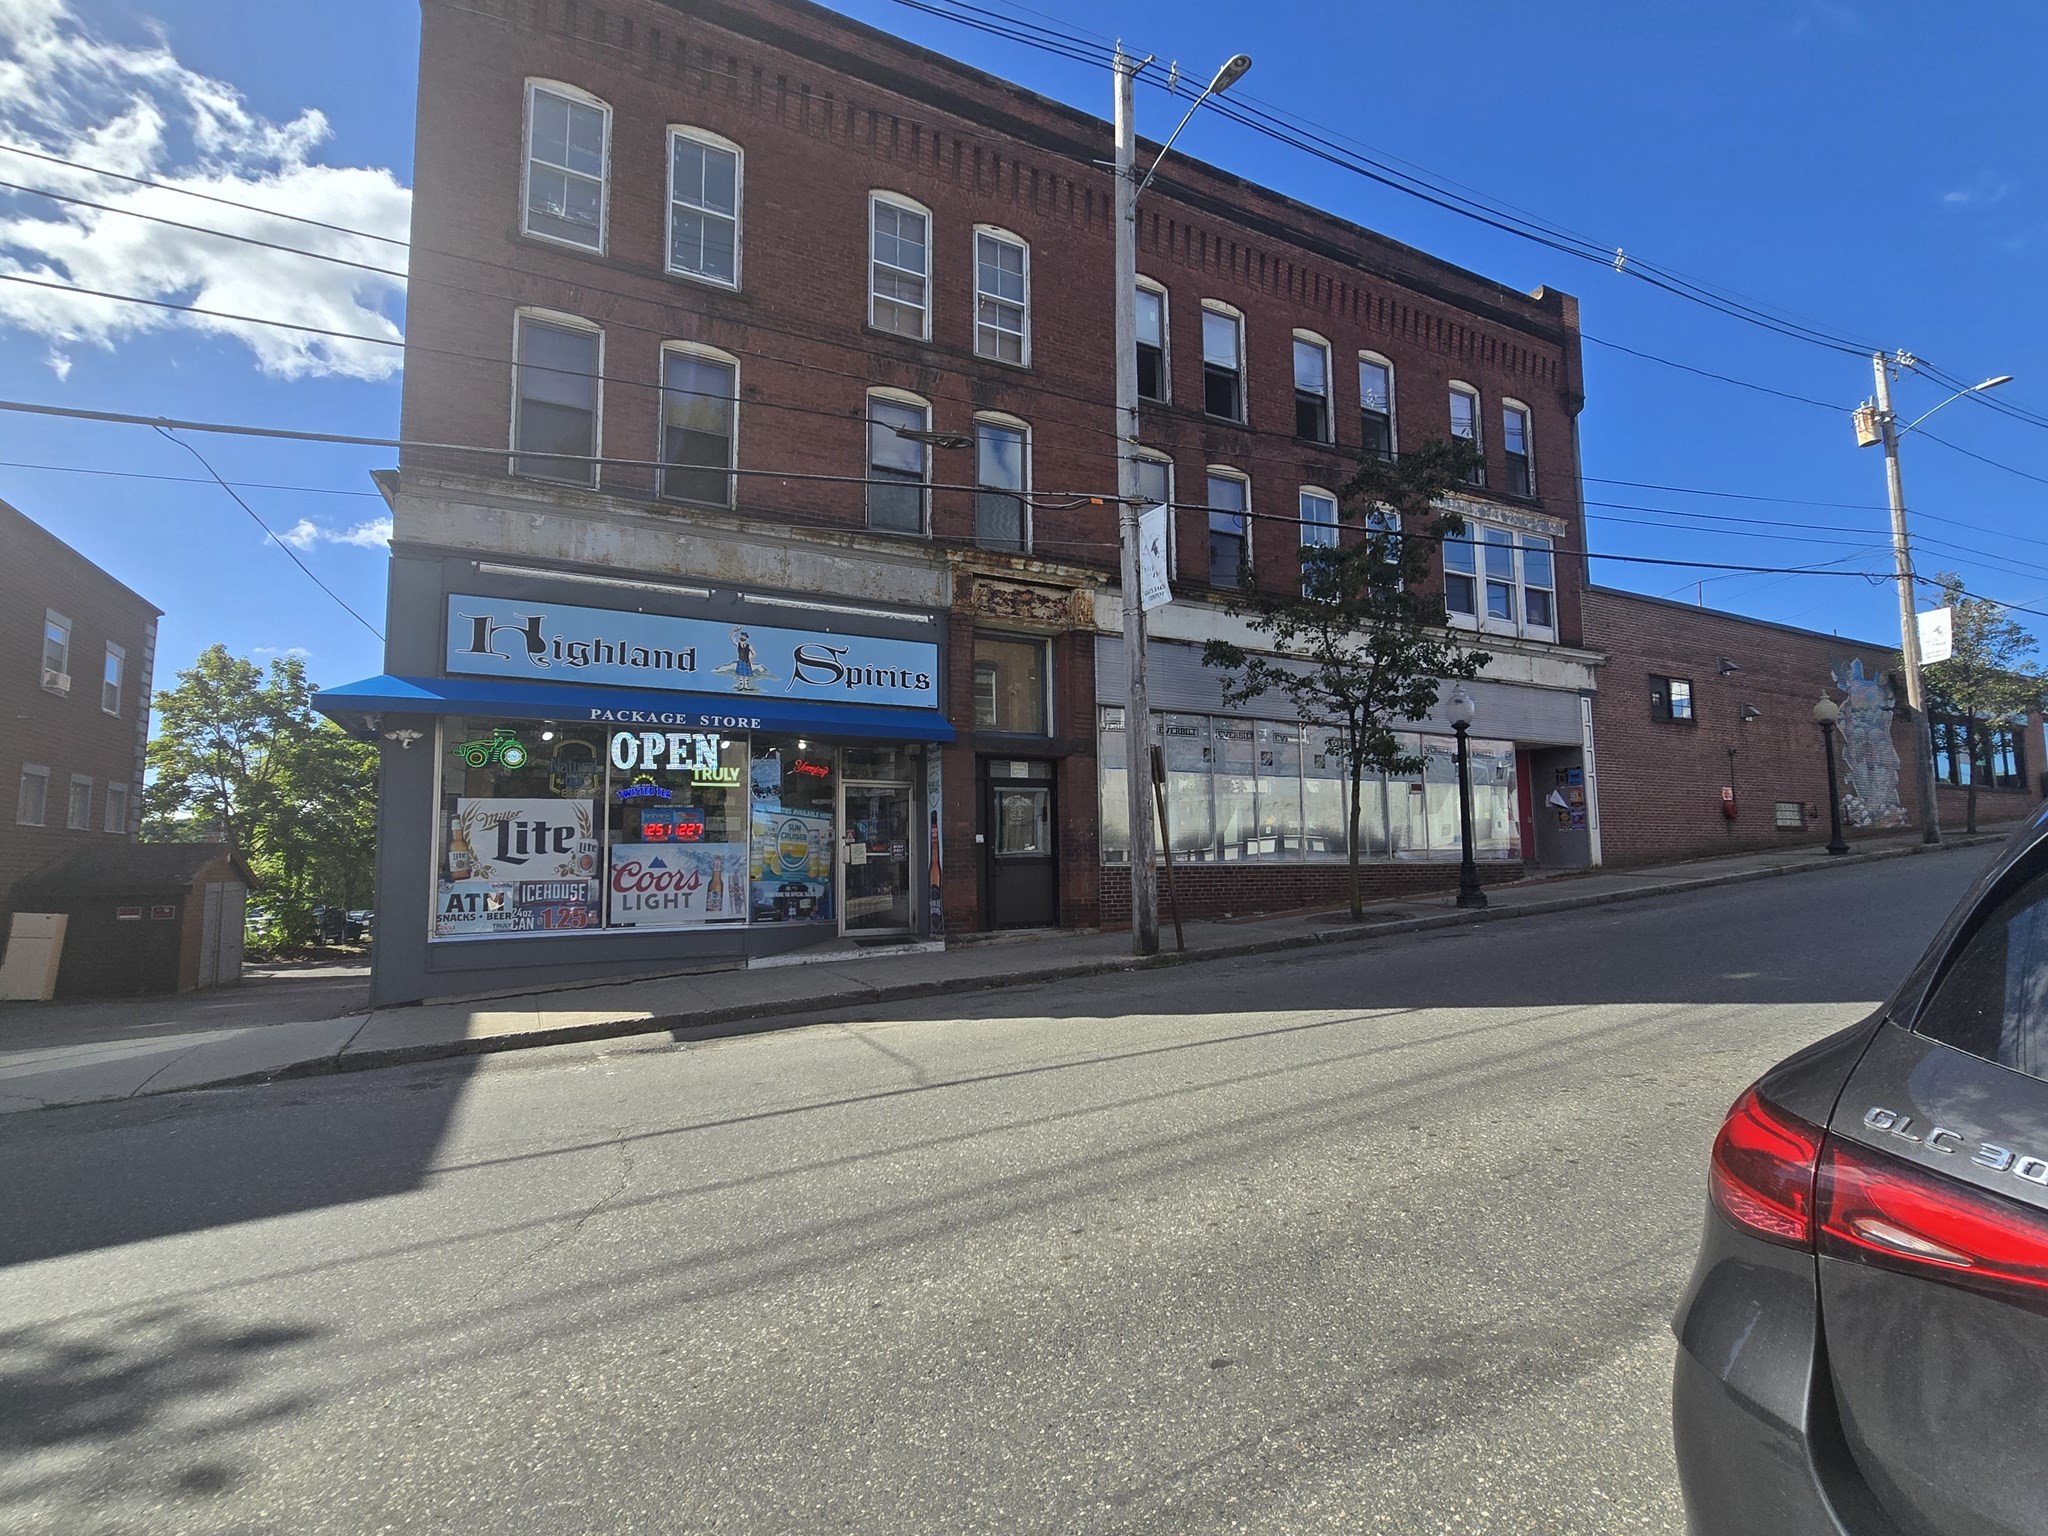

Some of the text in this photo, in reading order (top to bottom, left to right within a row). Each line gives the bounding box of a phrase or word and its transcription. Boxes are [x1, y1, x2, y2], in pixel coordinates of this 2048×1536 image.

[455, 612, 931, 691] Highland Spirits
[589, 708, 761, 729] PACKAGE STORE
[611, 731, 720, 770] OPEN
[692, 767, 740, 781] TRULY
[616, 786, 673, 800] TWISTED TEA
[476, 810, 523, 831] Miller
[492, 820, 575, 865] Lite
[579, 842, 598, 853] Lite
[611, 861, 702, 893] Coors
[445, 892, 505, 913] ATM
[522, 884, 586, 903] ICEHOUSE
[622, 892, 693, 911] LIGHT
[437, 912, 512, 923] SNACKS BEER
[512, 918, 534, 931] CAN
[1863, 1106, 2048, 1187] GLC 30
